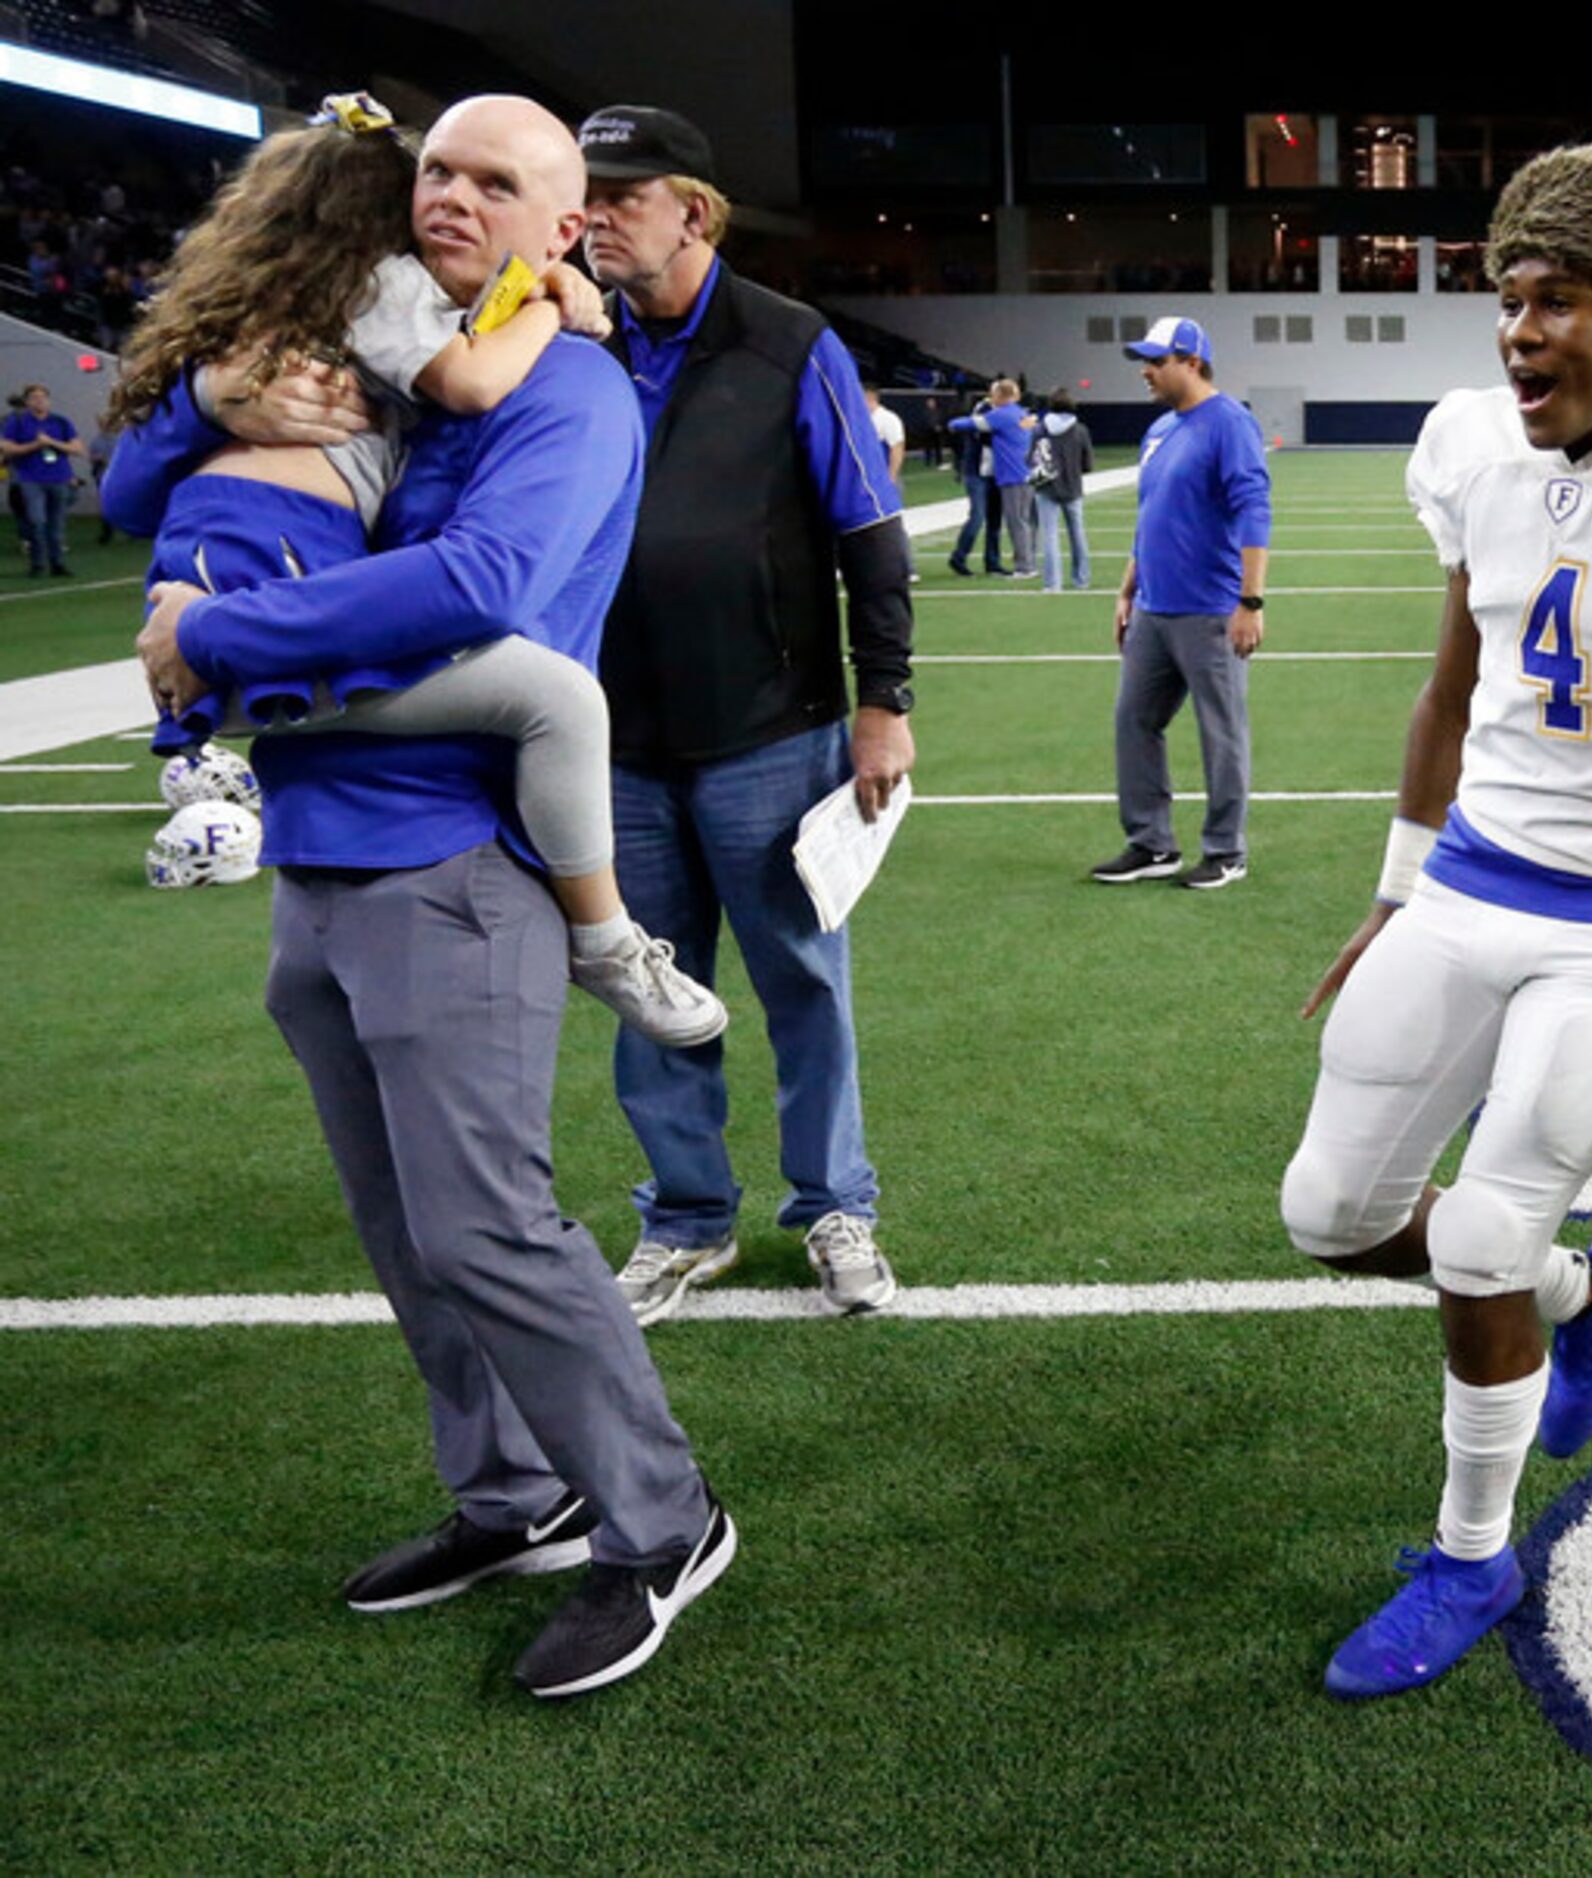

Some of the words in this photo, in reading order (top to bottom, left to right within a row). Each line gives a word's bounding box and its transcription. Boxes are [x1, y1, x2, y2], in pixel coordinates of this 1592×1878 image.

[1555, 485, 1573, 511] F
[1516, 555, 1592, 743] 4
[205, 823, 231, 856] F
